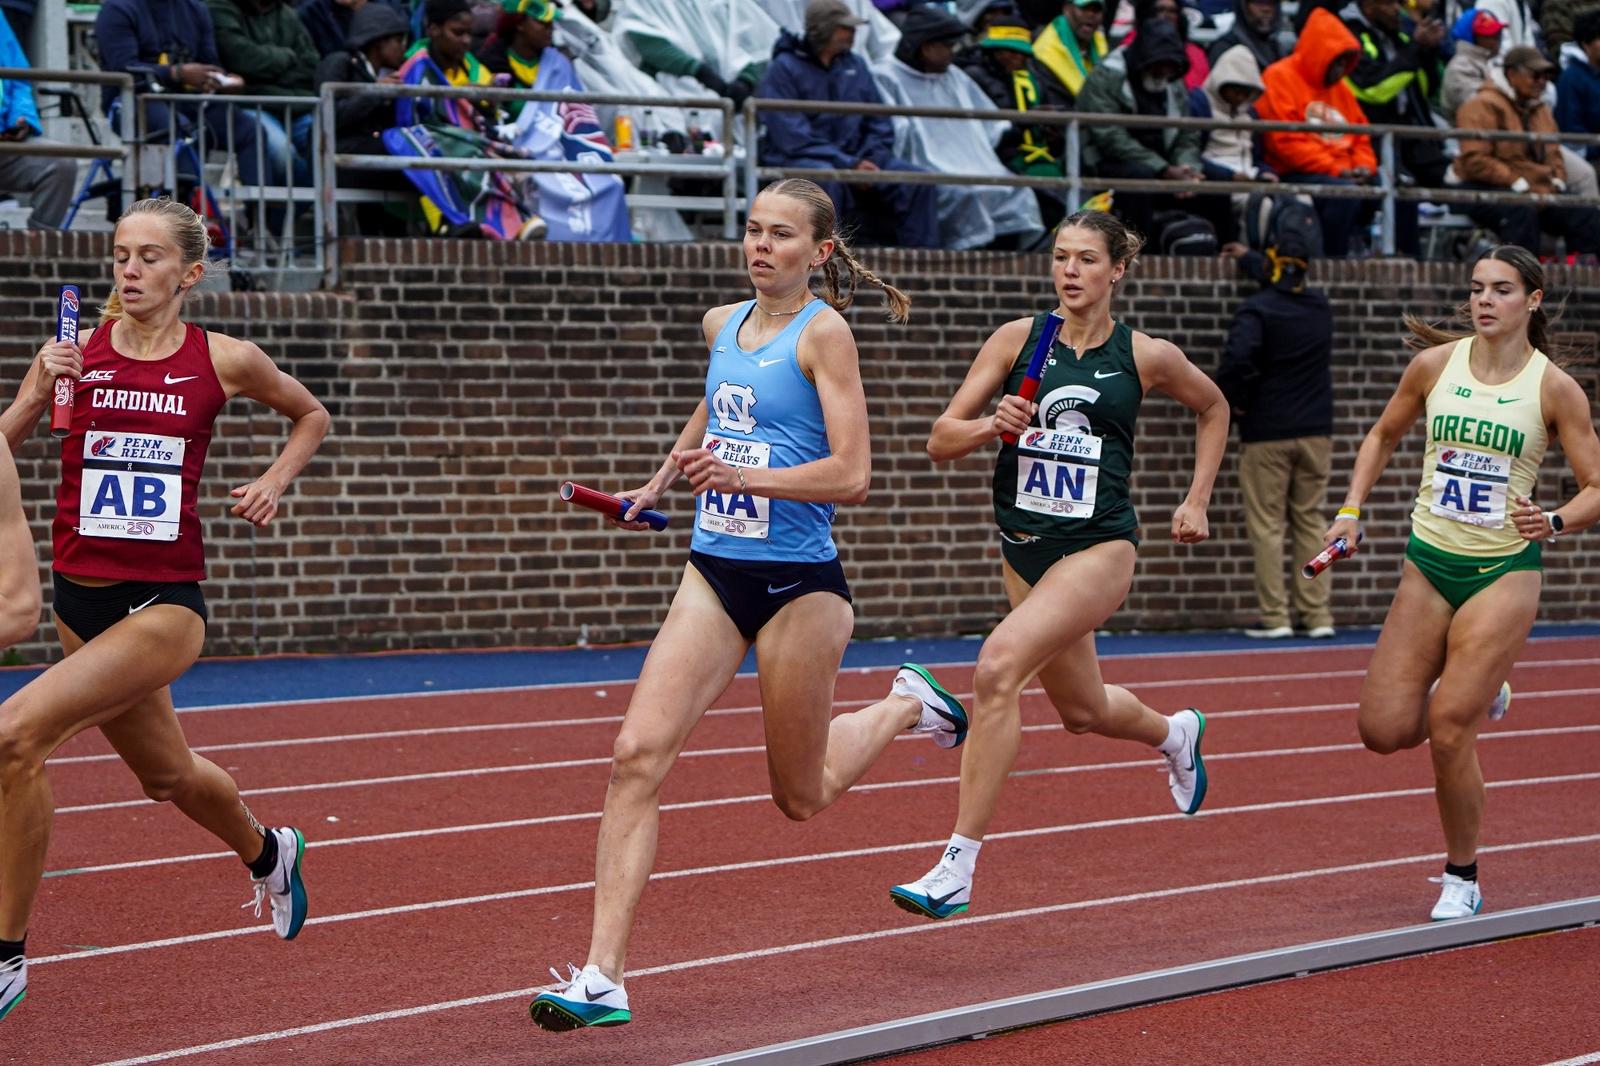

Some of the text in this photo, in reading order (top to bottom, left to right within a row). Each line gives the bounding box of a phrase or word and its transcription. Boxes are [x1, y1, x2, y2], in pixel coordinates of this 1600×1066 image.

[81, 369, 117, 381] ACC
[92, 388, 187, 416] CARDINAL
[123, 437, 163, 449] PENN
[1051, 433, 1084, 445] PENN
[1432, 415, 1525, 459] OREGON
[120, 448, 173, 461] RELAYS
[725, 441, 752, 454] PENN
[1048, 442, 1092, 455] RELAYS
[722, 451, 760, 466] RELAYS
[1463, 452, 1493, 463] PENN
[1460, 461, 1501, 472] RELAYS
[1023, 461, 1086, 501] AN
[90, 474, 167, 518] AB
[1440, 478, 1493, 513] AE
[704, 487, 758, 519] AA
[1051, 502, 1074, 514] 250
[97, 521, 155, 536] AMERICA 250
[725, 519, 747, 534] 250
